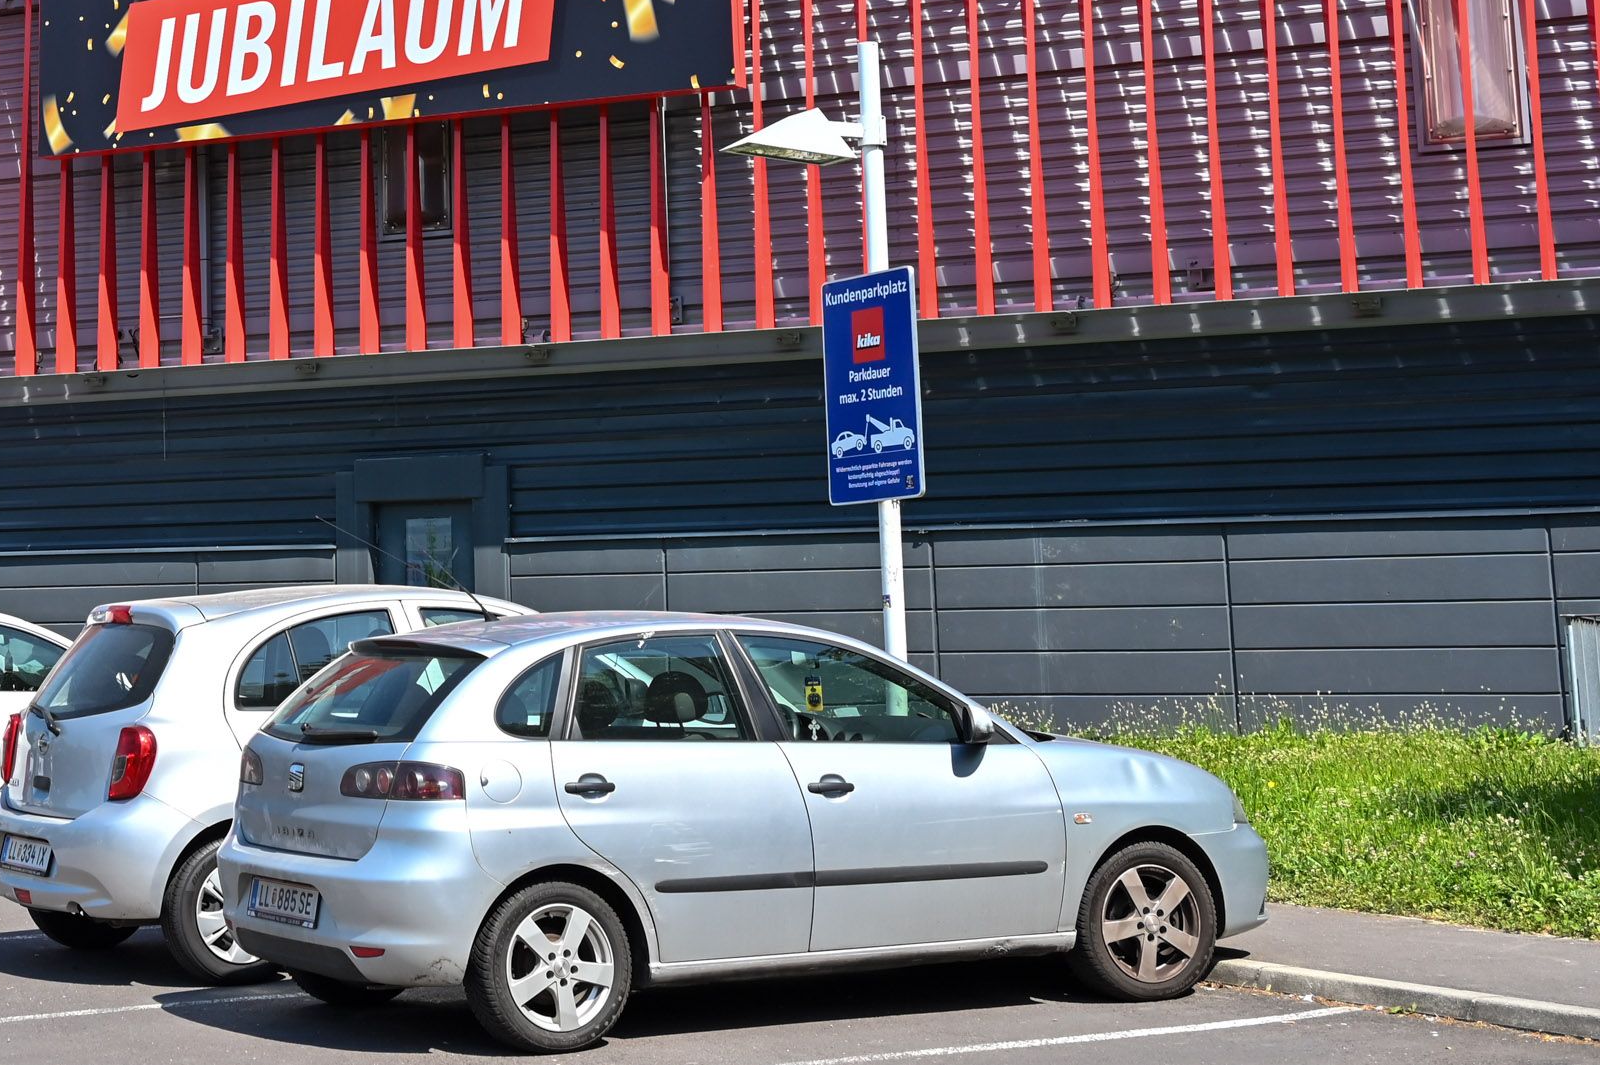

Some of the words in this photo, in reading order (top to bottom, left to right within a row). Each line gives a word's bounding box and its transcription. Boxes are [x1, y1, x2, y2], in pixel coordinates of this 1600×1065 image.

[825, 280, 907, 306] Kundenparkplatz
[856, 333, 881, 349] kika
[849, 366, 891, 383] Parkdauer
[840, 393, 859, 405] max.
[861, 389, 867, 402] 2
[868, 384, 902, 401] Stunden
[8, 838, 17, 861] LL
[20, 843, 37, 864] 334
[36, 847, 48, 867] IX
[259, 884, 270, 908] LL
[277, 888, 298, 913] 885
[298, 891, 314, 916] SE
